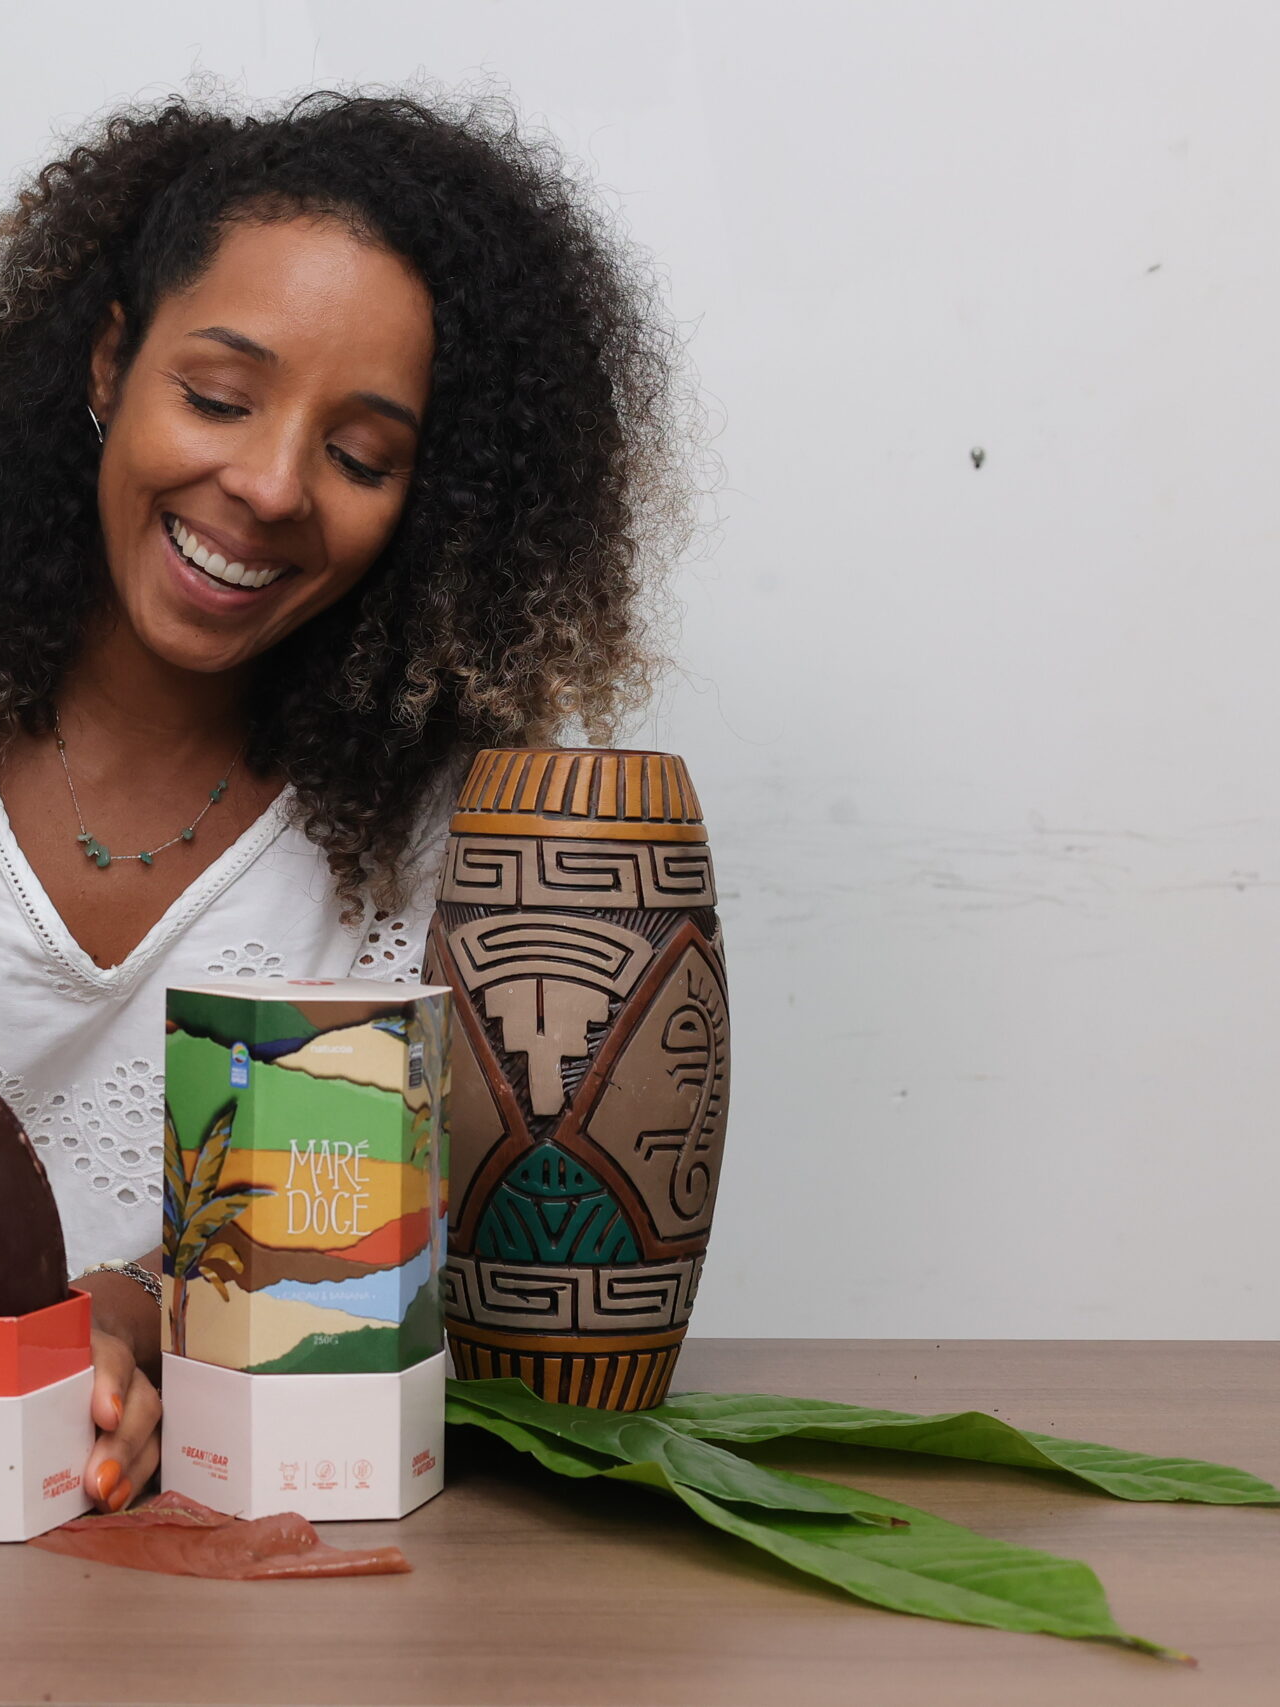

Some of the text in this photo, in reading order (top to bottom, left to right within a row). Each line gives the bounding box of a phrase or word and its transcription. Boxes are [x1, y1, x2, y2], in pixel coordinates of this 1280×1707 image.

[285, 1139, 370, 1196] MARÉ
[286, 1191, 372, 1235] DOCE
[313, 1335, 339, 1345] 250G
